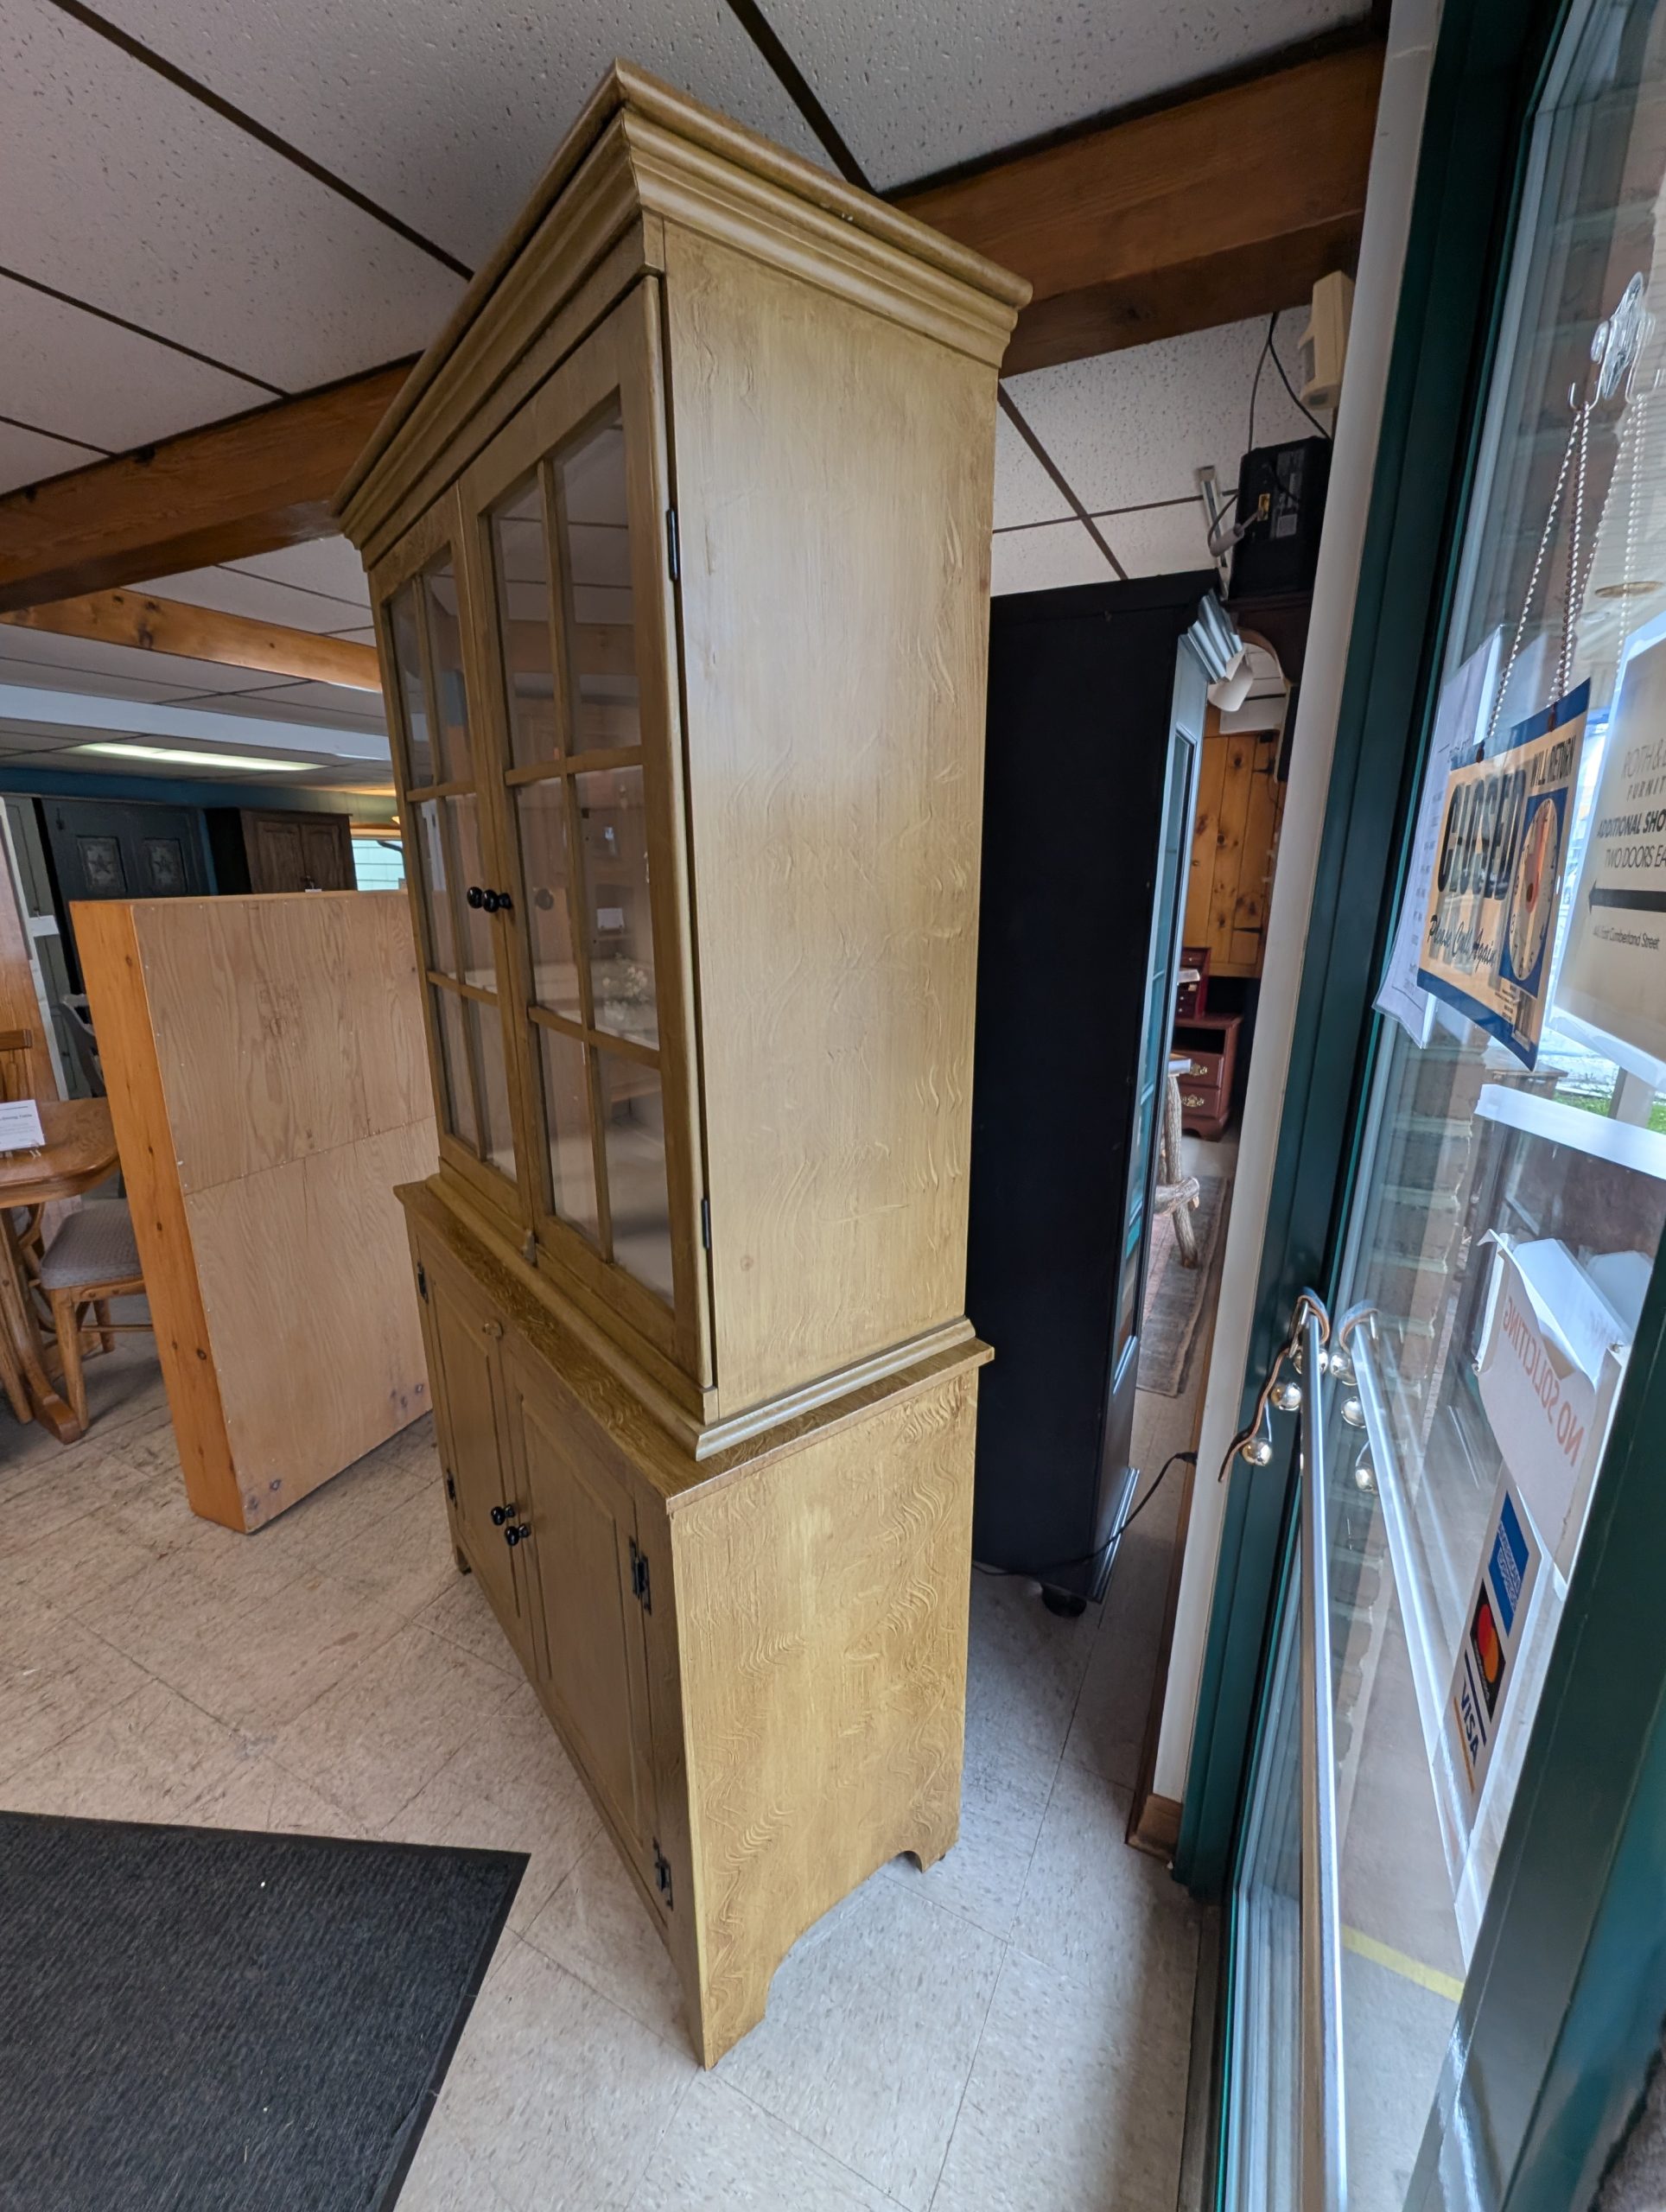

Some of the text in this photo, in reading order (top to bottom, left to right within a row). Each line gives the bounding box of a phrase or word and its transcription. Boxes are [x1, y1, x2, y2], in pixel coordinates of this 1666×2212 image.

[1438, 769, 1527, 900] CLOSED
[1597, 809, 1666, 837] ADDITIONAL SHO
[1605, 848, 1622, 868] TWO
[1622, 845, 1655, 868] DOORS
[1428, 914, 1453, 947] Please
[1470, 928, 1496, 973] Again
[1642, 931, 1660, 950] Street
[1461, 1675, 1479, 1769] VISA
